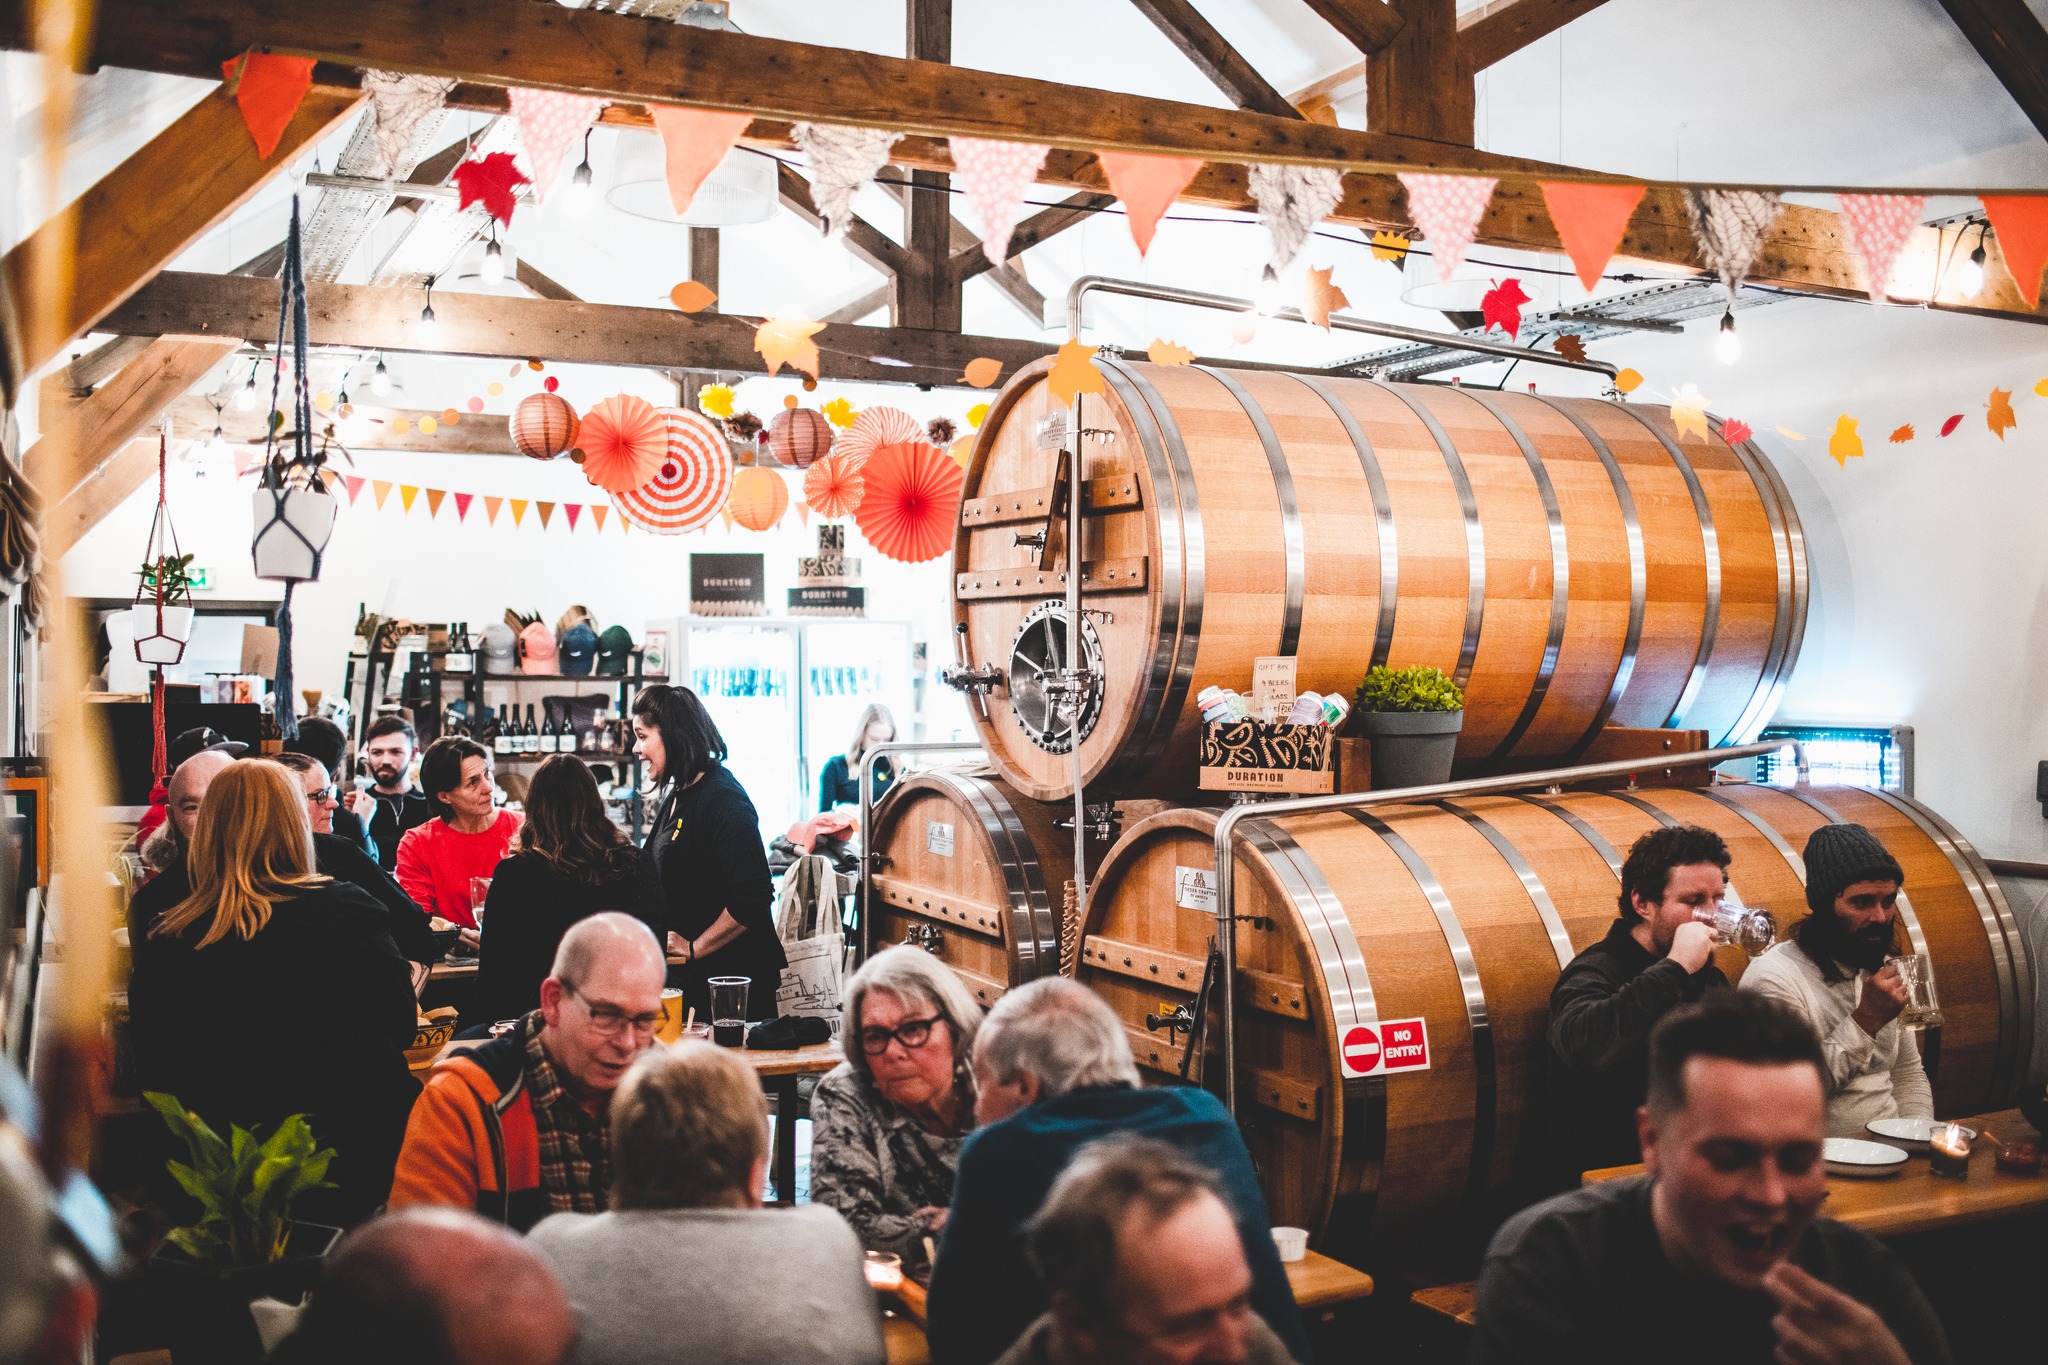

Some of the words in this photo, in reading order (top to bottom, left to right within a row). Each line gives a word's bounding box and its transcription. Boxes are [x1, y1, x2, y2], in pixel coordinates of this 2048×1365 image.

[703, 578, 751, 587] DURATION
[801, 590, 848, 600] DURATION
[1227, 771, 1284, 782] DURATION
[1393, 1030, 1412, 1042] NO
[1385, 1044, 1423, 1058] ENTRY
